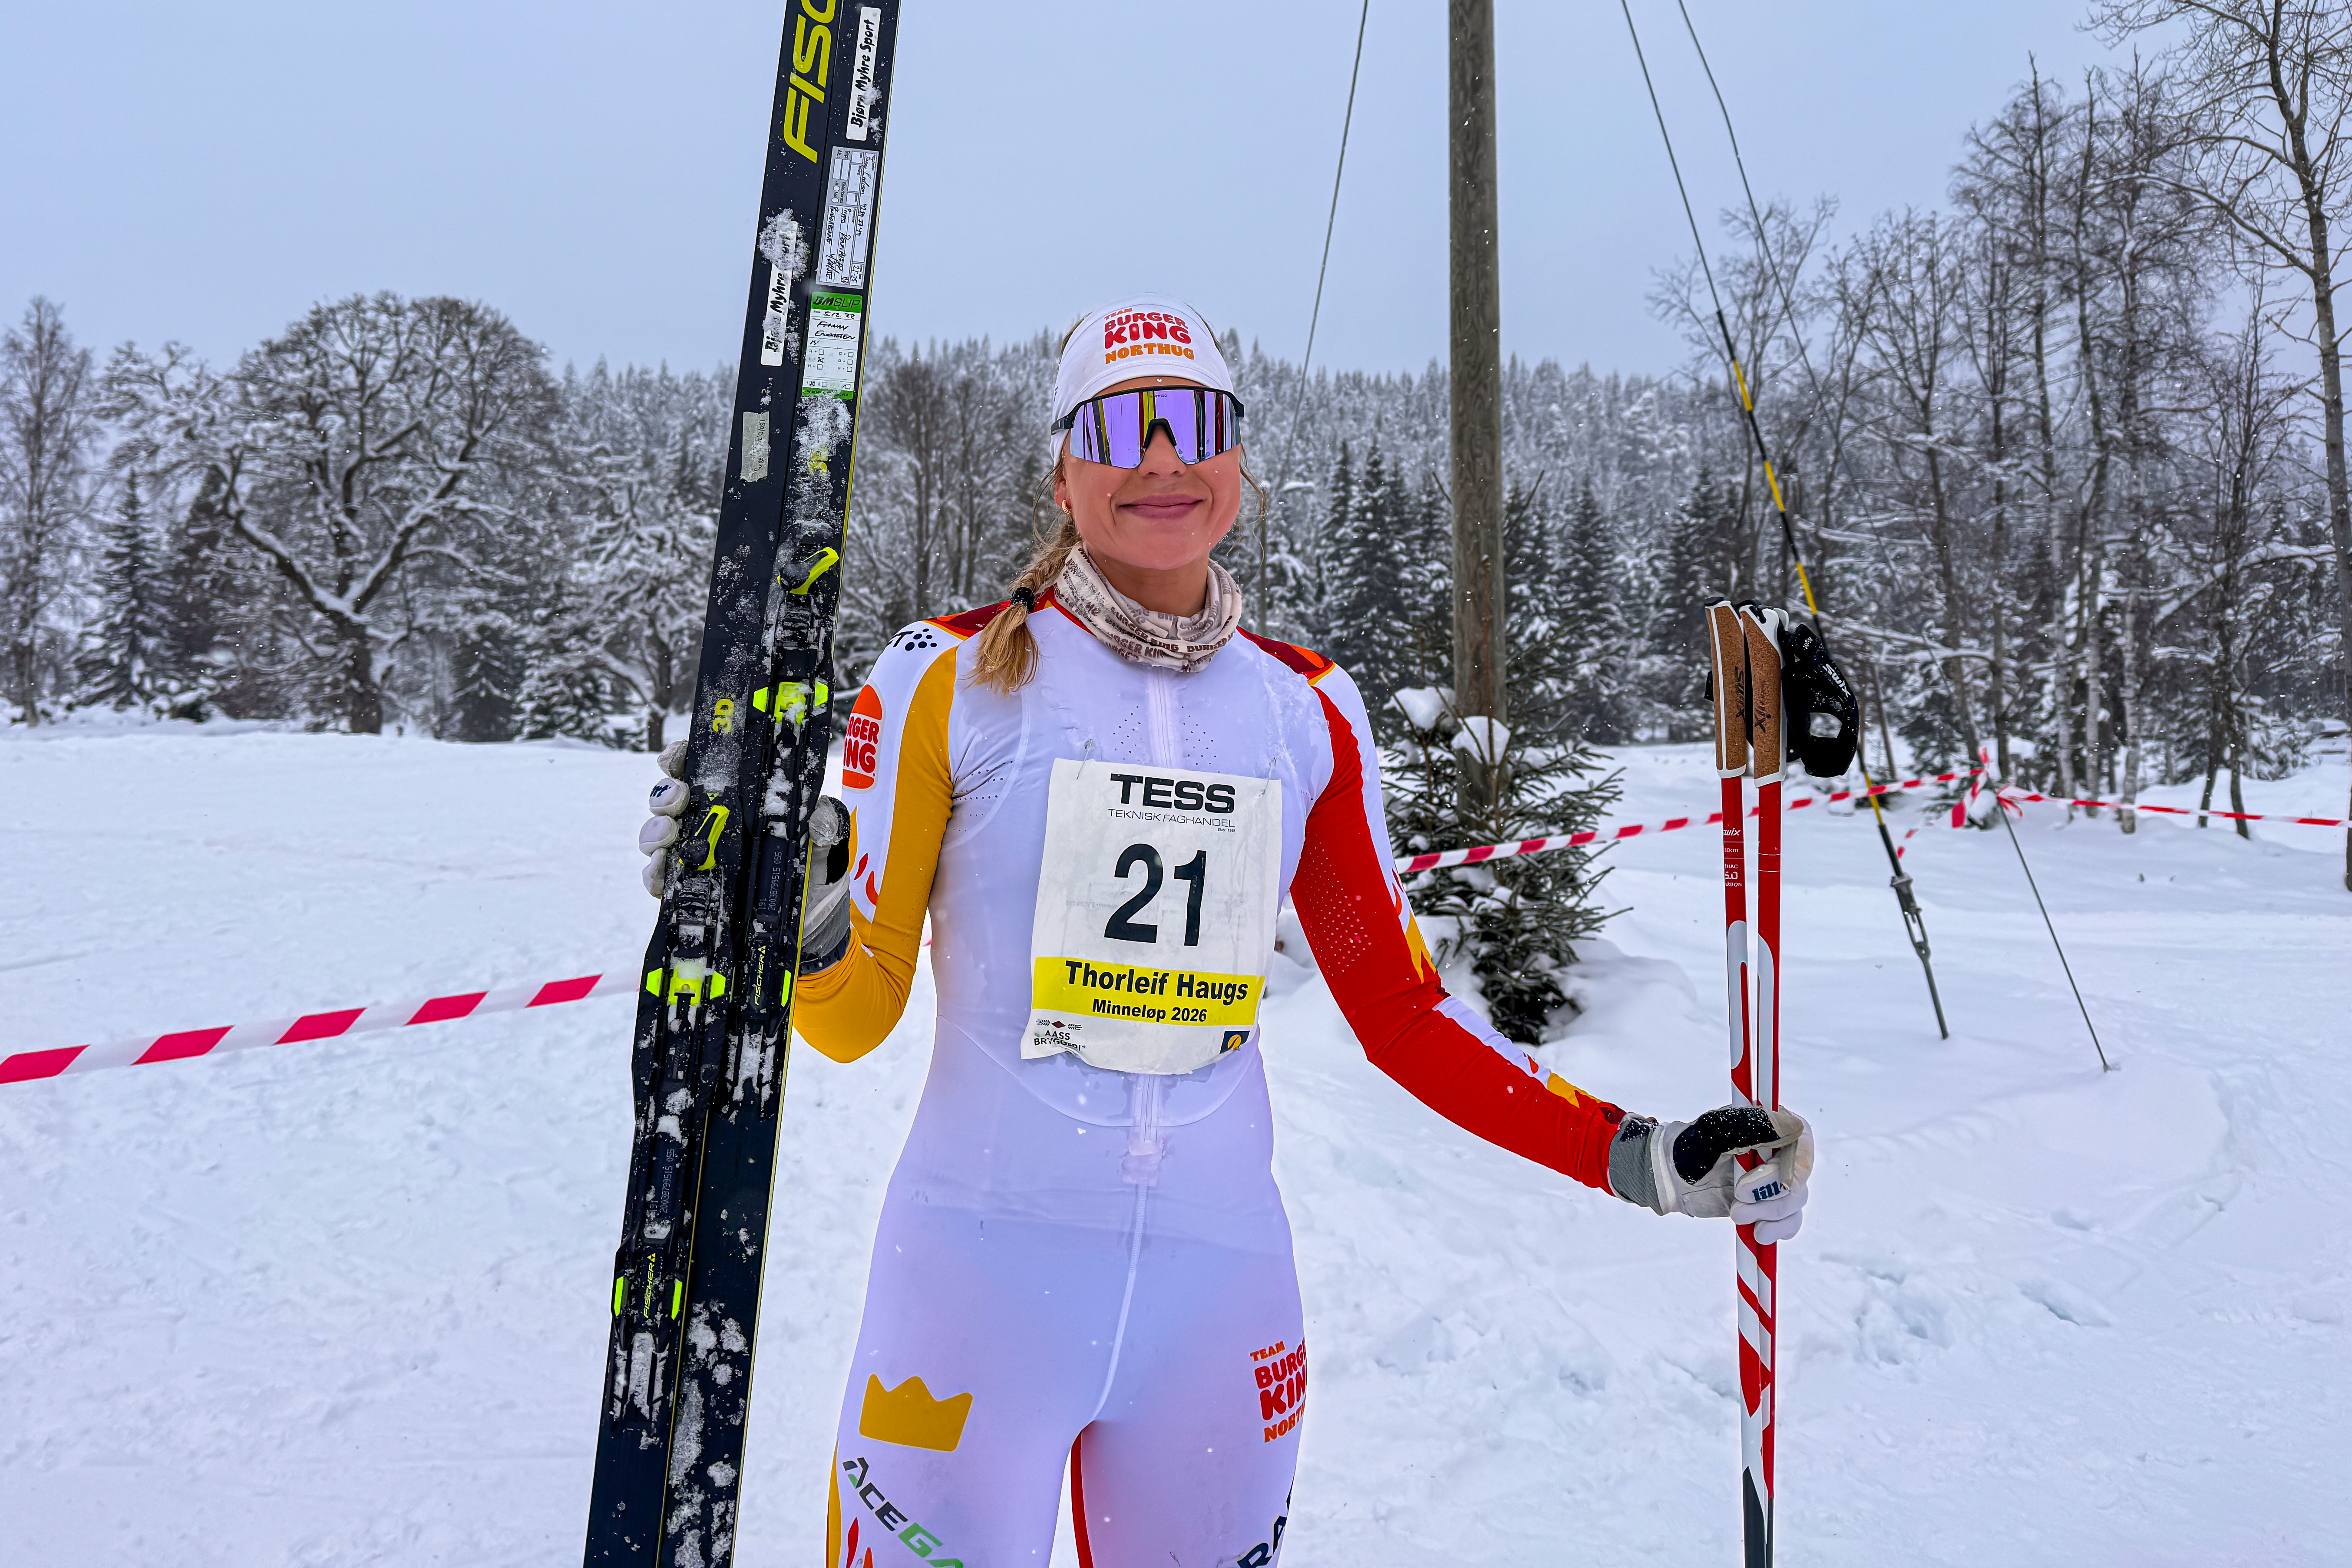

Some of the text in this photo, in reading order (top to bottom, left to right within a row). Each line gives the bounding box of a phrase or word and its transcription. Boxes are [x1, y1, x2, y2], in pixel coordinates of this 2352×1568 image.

[859, 19, 875, 53] Sport
[855, 54, 871, 92] Myhre
[770, 272, 787, 313] Myhre
[1104, 307, 1133, 321] TEAM
[1104, 312, 1189, 332] BURGER
[1105, 322, 1192, 349] KING
[1105, 343, 1195, 365] NORTHUG
[1110, 773, 1235, 814] TESS
[1108, 808, 1236, 828] TEKNISK FAGHANDEL
[1104, 842, 1207, 947] 21
[754, 954, 765, 1006] FISCHER
[1065, 960, 1249, 1006] Thorleif Haugs
[1092, 998, 1208, 1023] Minneløp 2026
[1045, 1030, 1070, 1040] AASS
[643, 1262, 655, 1318] FISCHER
[1250, 1340, 1285, 1362] TEAM
[1259, 1357, 1307, 1421] KIN
